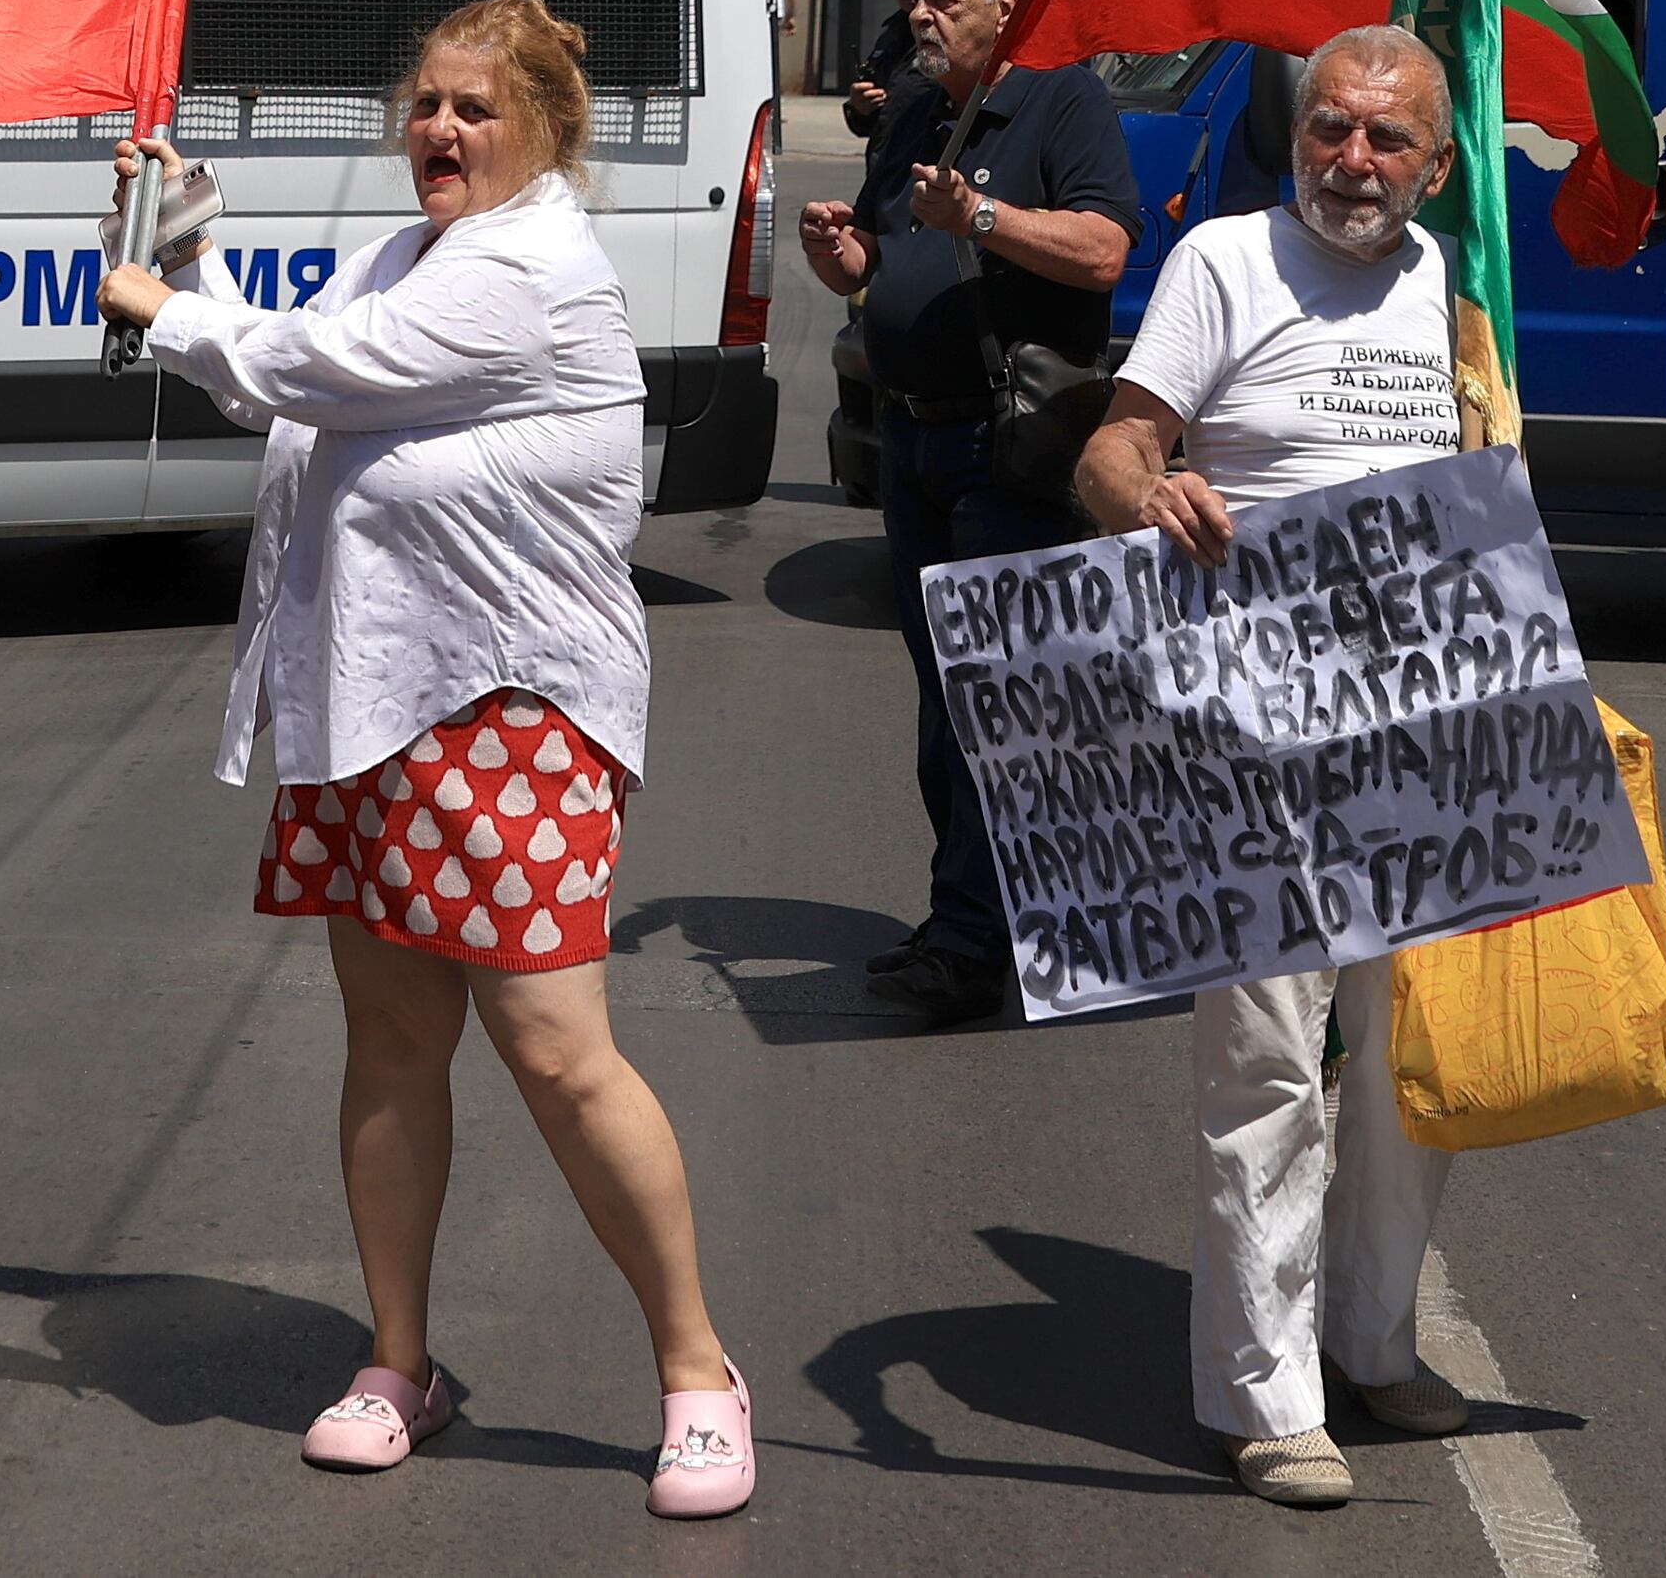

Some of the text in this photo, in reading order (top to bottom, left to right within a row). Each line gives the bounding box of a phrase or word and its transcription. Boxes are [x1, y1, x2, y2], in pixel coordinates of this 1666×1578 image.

[1331, 371, 1356, 388] ЗА
[1340, 346, 1445, 369] ДВИЖЕНИЕ
[1299, 394, 1459, 421] И БЛАГОДЕНСТ
[1341, 422, 1460, 450] НА НАРОДА
[926, 552, 1114, 662] ЕВРОТО
[1165, 628, 1206, 696] В
[1170, 694, 1245, 762] НА
[979, 741, 1234, 840] ИЗКОПАХА
[995, 815, 1222, 914] НАРОДЕН
[1015, 887, 1257, 1001] ЗАТВОР
[1278, 876, 1353, 955] ДО
